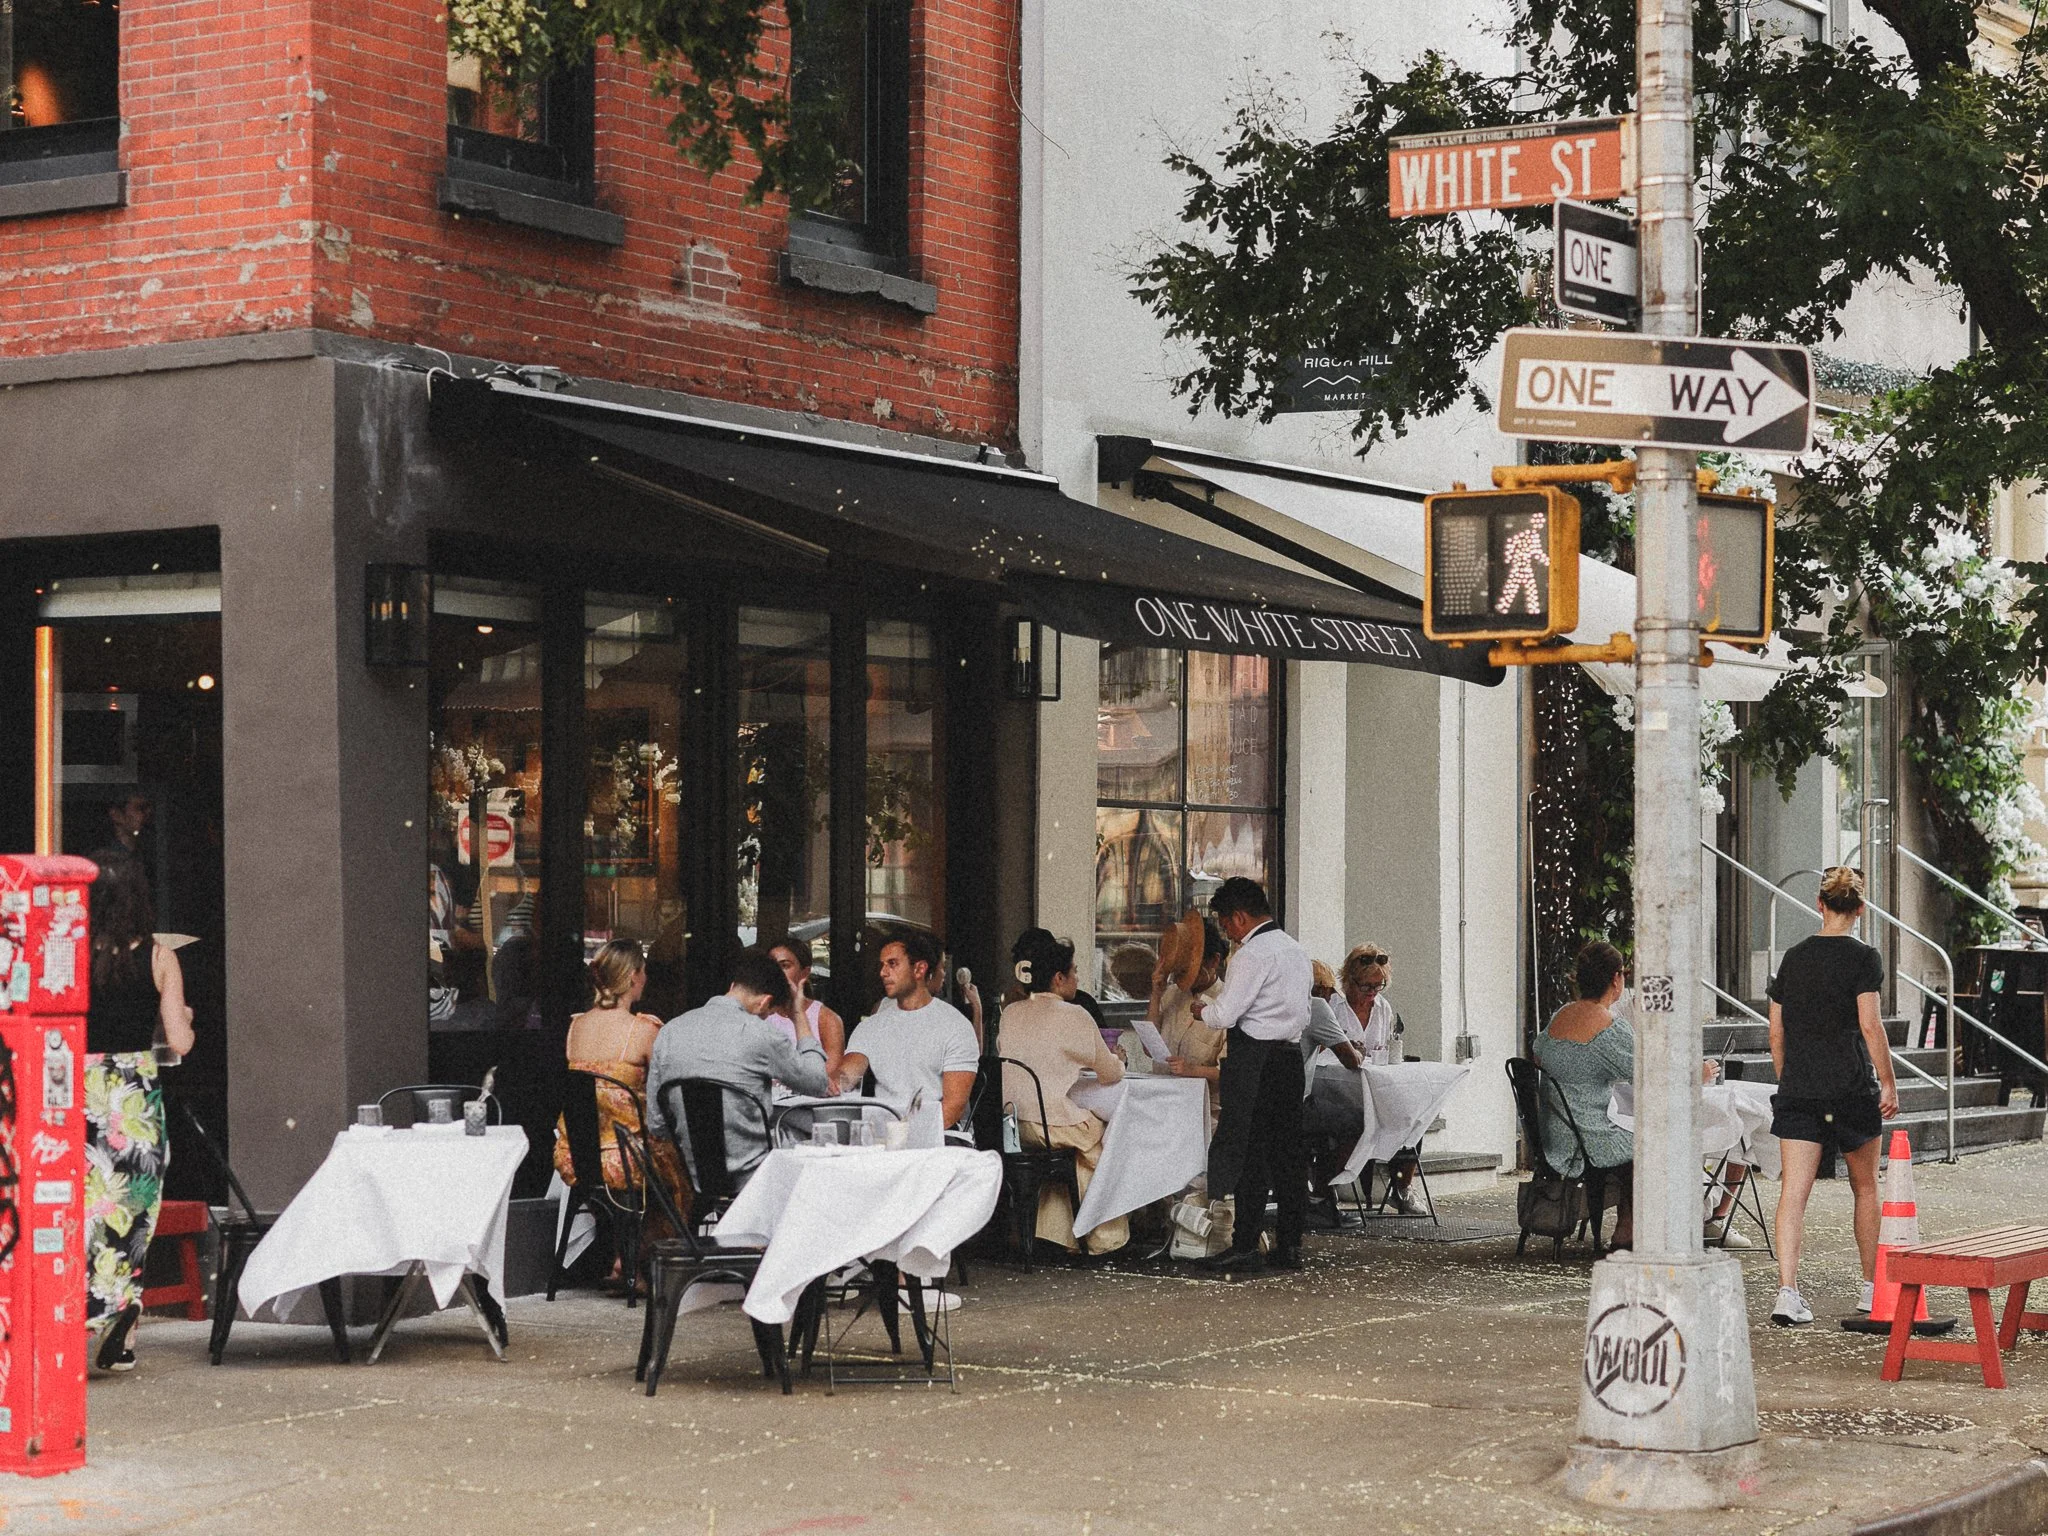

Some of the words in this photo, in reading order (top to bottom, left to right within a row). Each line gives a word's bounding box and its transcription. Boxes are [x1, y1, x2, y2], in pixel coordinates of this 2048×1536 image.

[1398, 139, 1439, 149] TRIBECA
[1440, 135, 1464, 146] EAST
[1466, 131, 1510, 144] HISTORIC
[1512, 126, 1557, 139] DISTRICT
[1400, 145, 1522, 212] WHITE
[1550, 138, 1598, 198] ST
[1571, 238, 1612, 284] ONE
[1358, 354, 1393, 366] HILL
[1324, 392, 1366, 401] MARKET
[1527, 364, 1616, 408] ONE
[1669, 373, 1771, 417] WAY
[1135, 596, 1210, 642] ONE
[1203, 604, 1316, 649] WHITE
[1310, 616, 1422, 660] STREET
